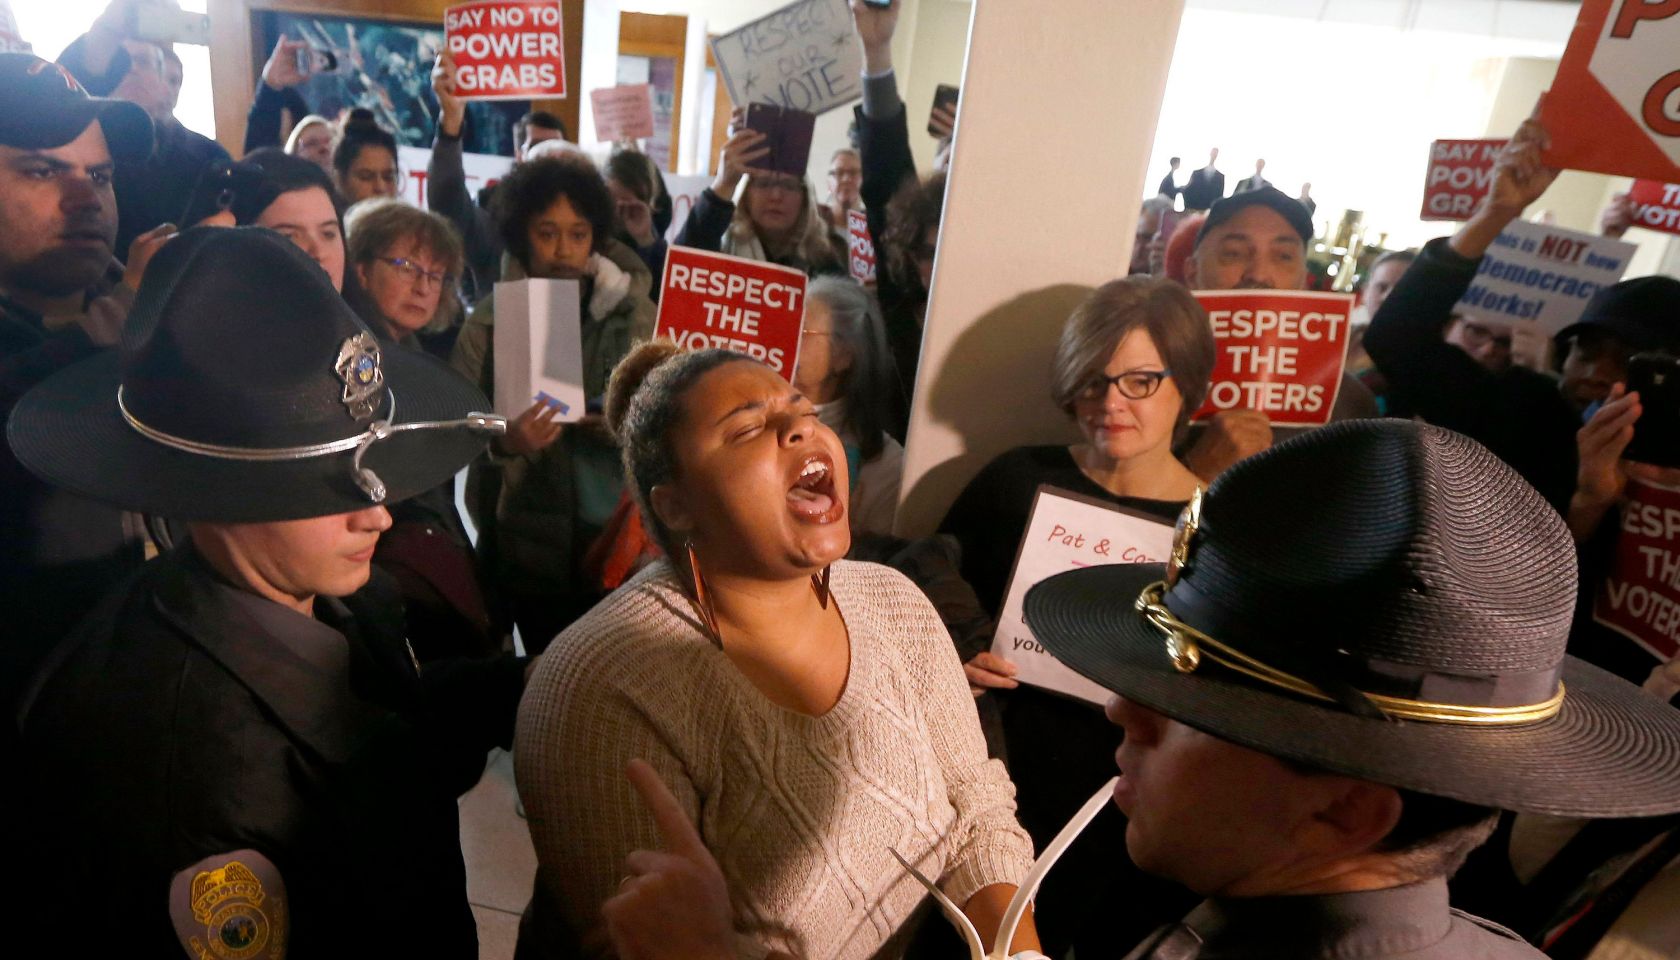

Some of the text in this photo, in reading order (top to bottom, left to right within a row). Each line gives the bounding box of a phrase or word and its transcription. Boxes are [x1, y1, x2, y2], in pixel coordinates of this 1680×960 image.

[447, 6, 560, 30] SAY NO TO
[449, 32, 560, 60] POWER
[778, 45, 828, 75] OUR
[456, 63, 556, 90] GRABS
[762, 58, 856, 114] VOTE
[1434, 143, 1478, 161] SAY
[1539, 235, 1588, 262] NOT
[669, 263, 802, 311] RESPECT
[703, 301, 761, 336] THE
[1208, 309, 1346, 342] ESPECT
[1226, 345, 1299, 375] THE
[1048, 524, 1157, 565] Pat & Co
[1606, 576, 1680, 645] VOTER
